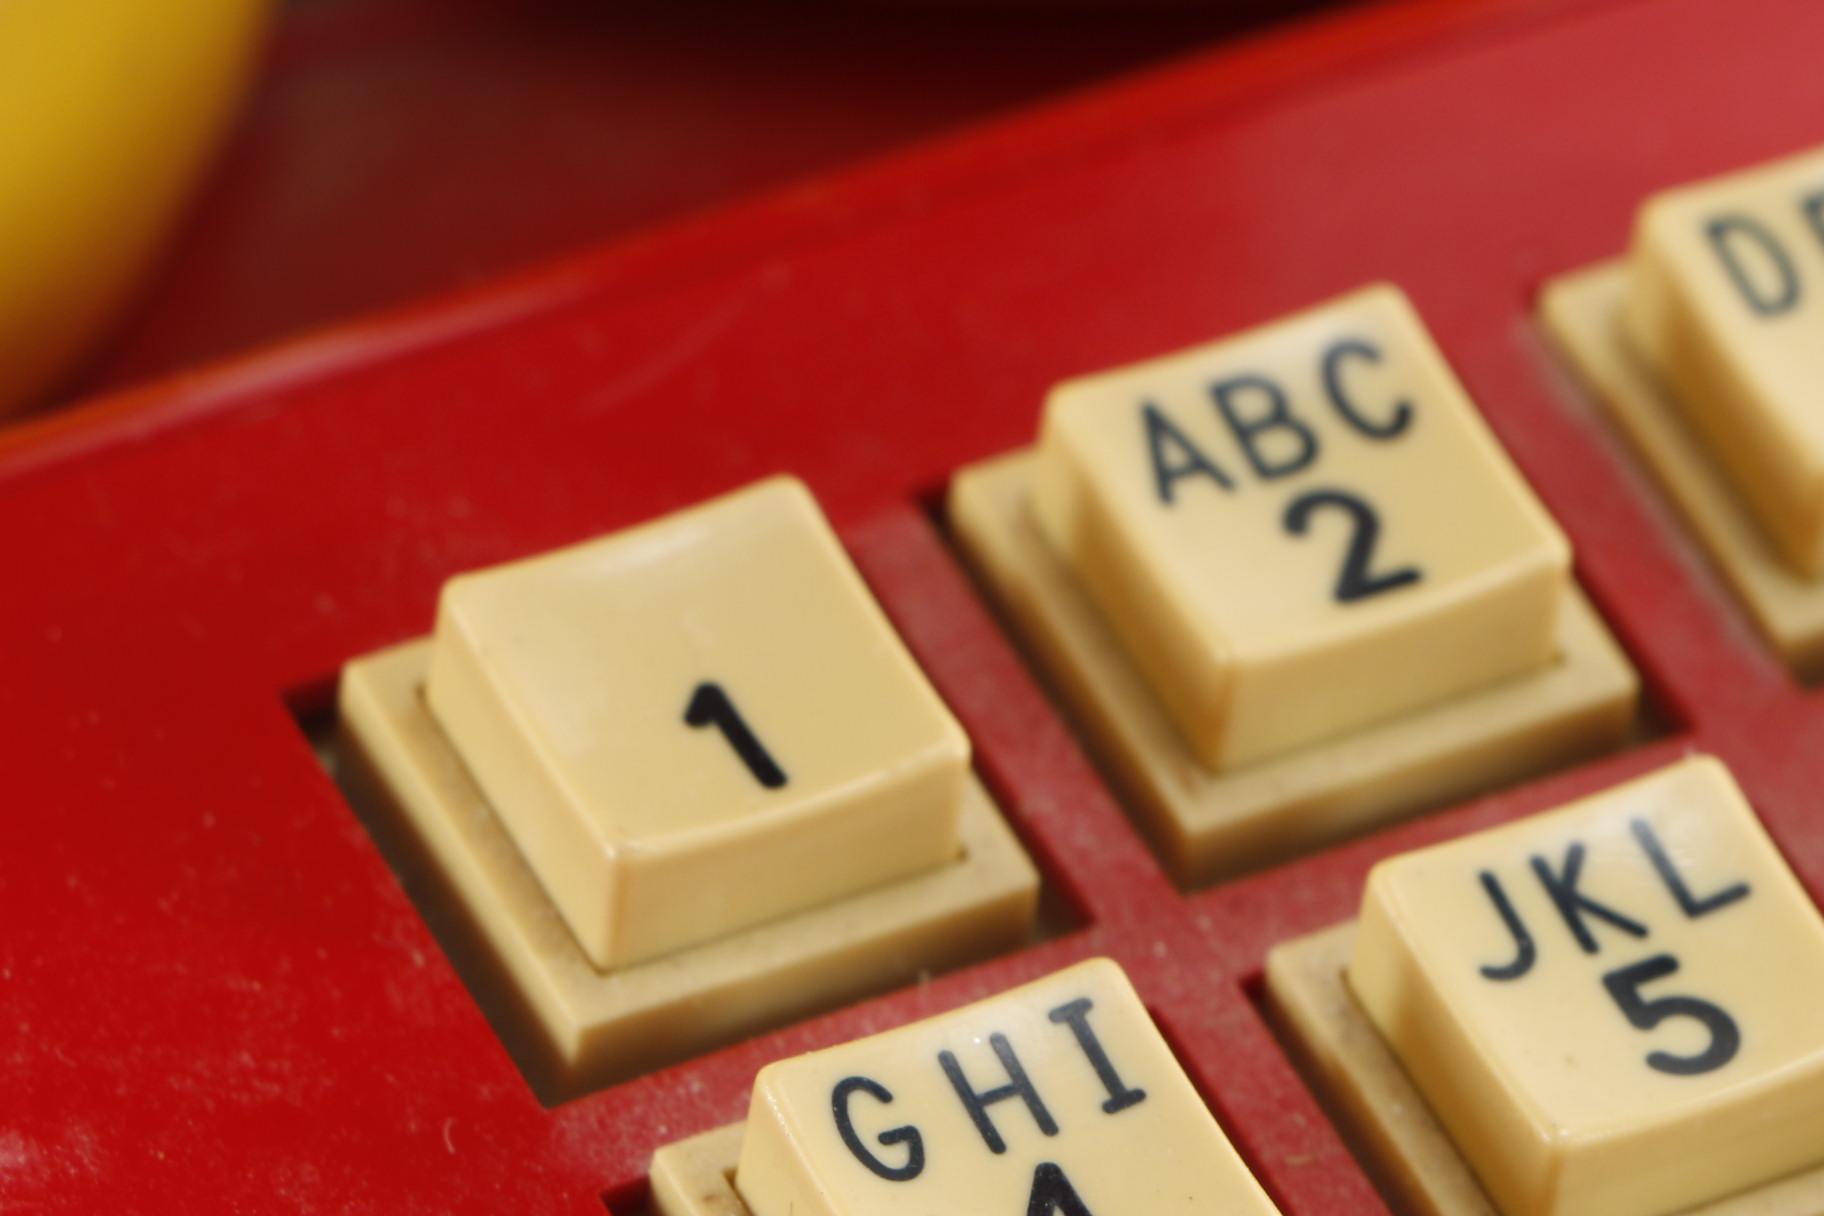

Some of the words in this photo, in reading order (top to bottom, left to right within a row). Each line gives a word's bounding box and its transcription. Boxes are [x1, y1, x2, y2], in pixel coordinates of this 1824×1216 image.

[1143, 341, 1413, 503] ABC
[1284, 489, 1422, 603] 2
[684, 681, 788, 790] 1
[1479, 817, 1749, 983] JKL
[1602, 953, 1740, 1076] 5
[832, 997, 1147, 1182] GHI
